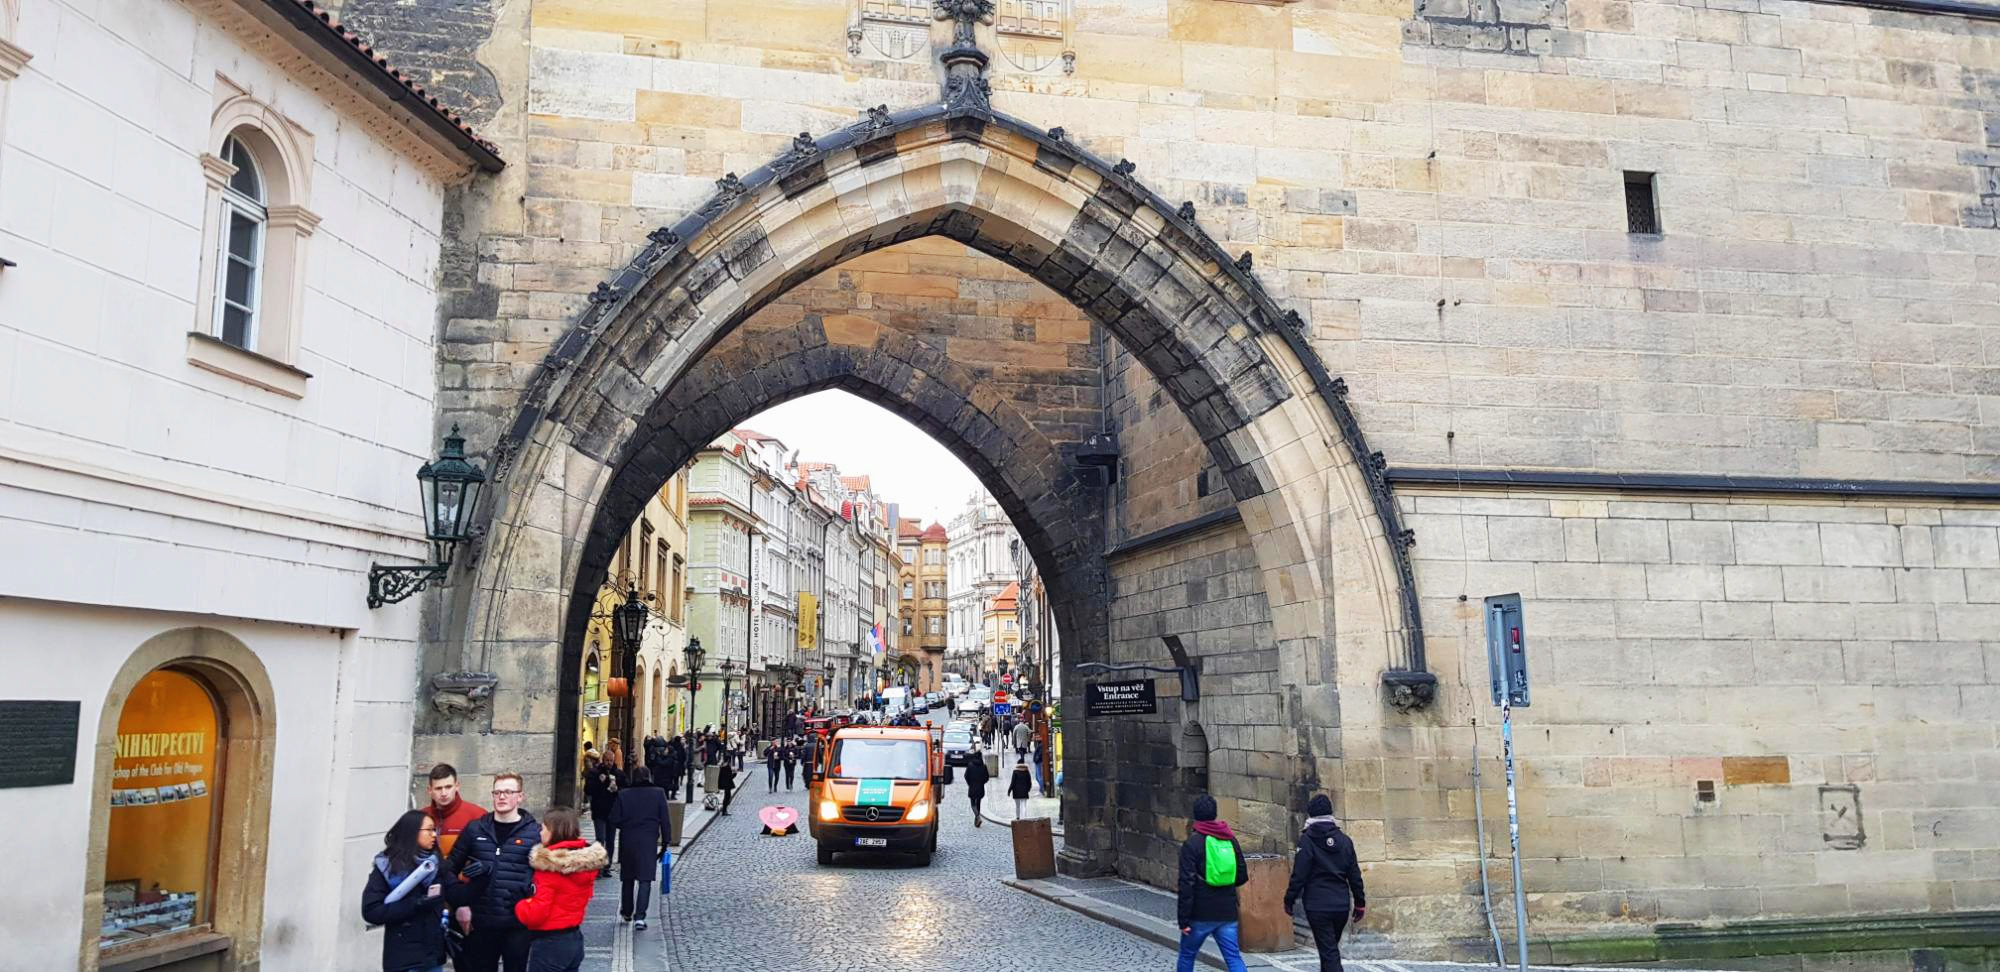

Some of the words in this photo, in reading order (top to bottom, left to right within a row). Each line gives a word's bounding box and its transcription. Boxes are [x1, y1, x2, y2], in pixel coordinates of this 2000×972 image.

[1097, 685, 1119, 694] Vstup
[1131, 683, 1145, 691] věž
[1103, 692, 1140, 700] Entrance
[112, 765, 130, 780] shop
[132, 763, 139, 777] of
[139, 763, 149, 776] the
[150, 762, 163, 776] Club
[163, 761, 173, 775] for
